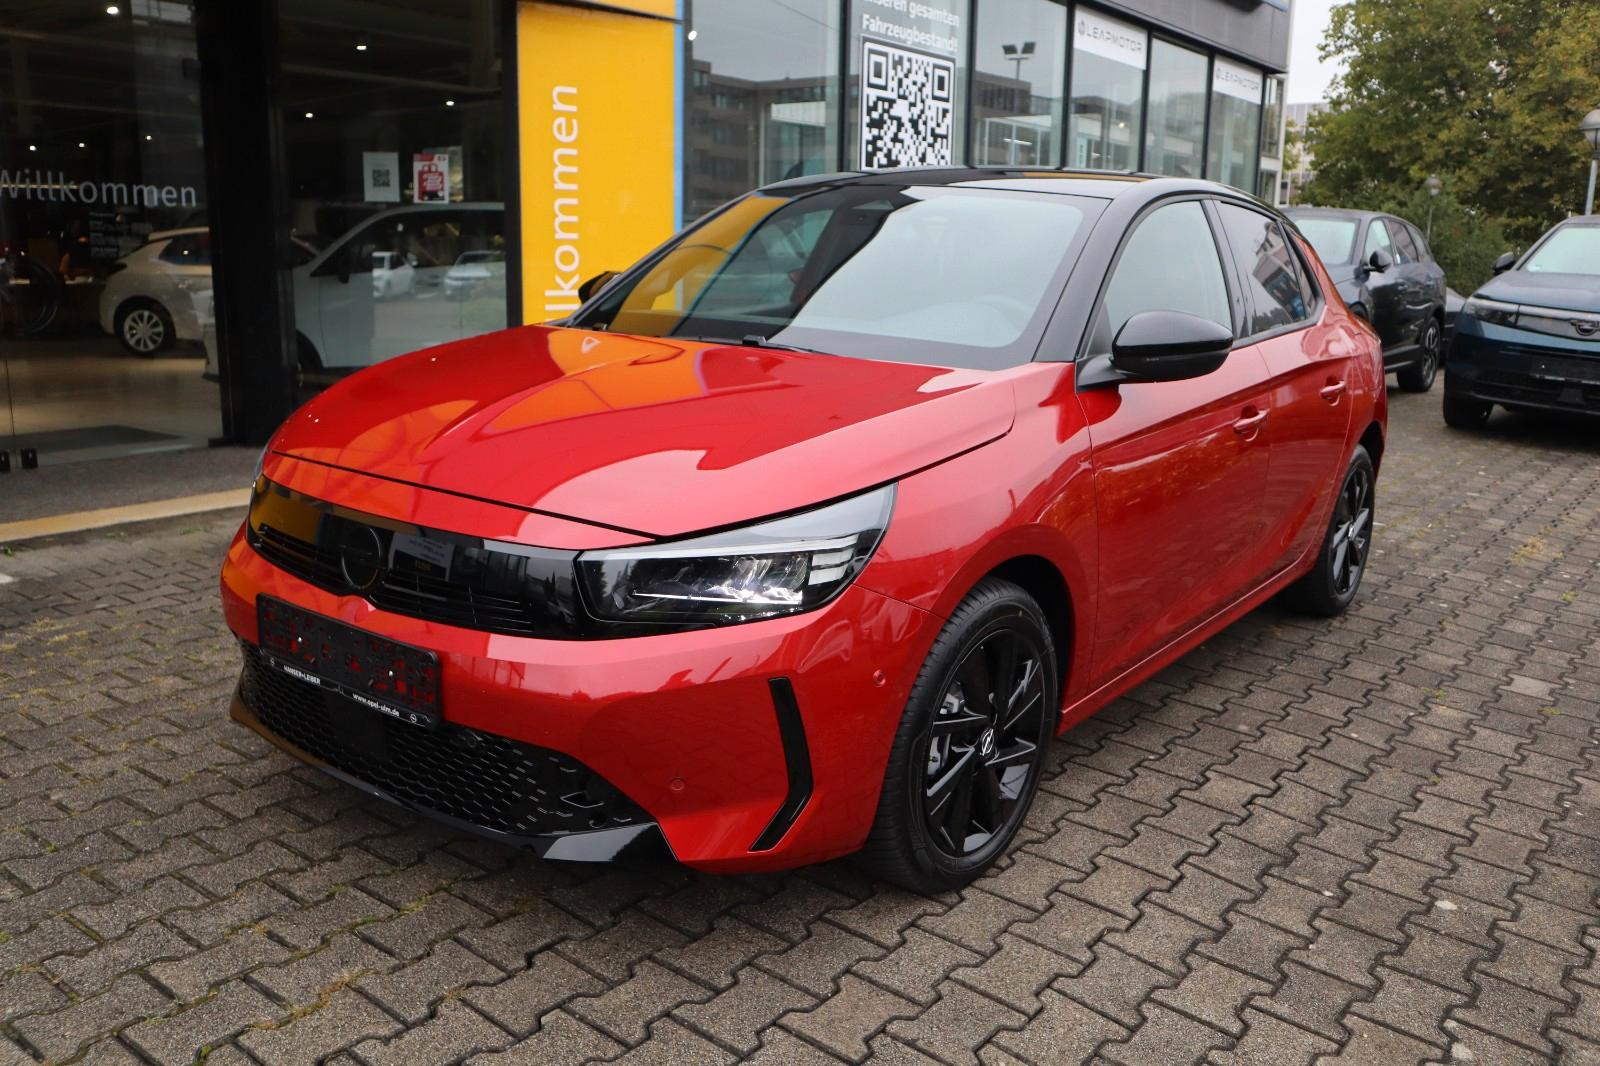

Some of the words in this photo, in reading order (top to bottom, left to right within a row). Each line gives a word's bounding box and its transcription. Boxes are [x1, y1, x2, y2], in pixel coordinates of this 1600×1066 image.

[862, 13, 958, 52] Fahrzeugbestand!
[909, 2, 959, 27] gesamten
[1087, 24, 1143, 53] LEAPMOTOR
[0, 168, 197, 207] Willkommen
[544, 85, 580, 321] lkommen
